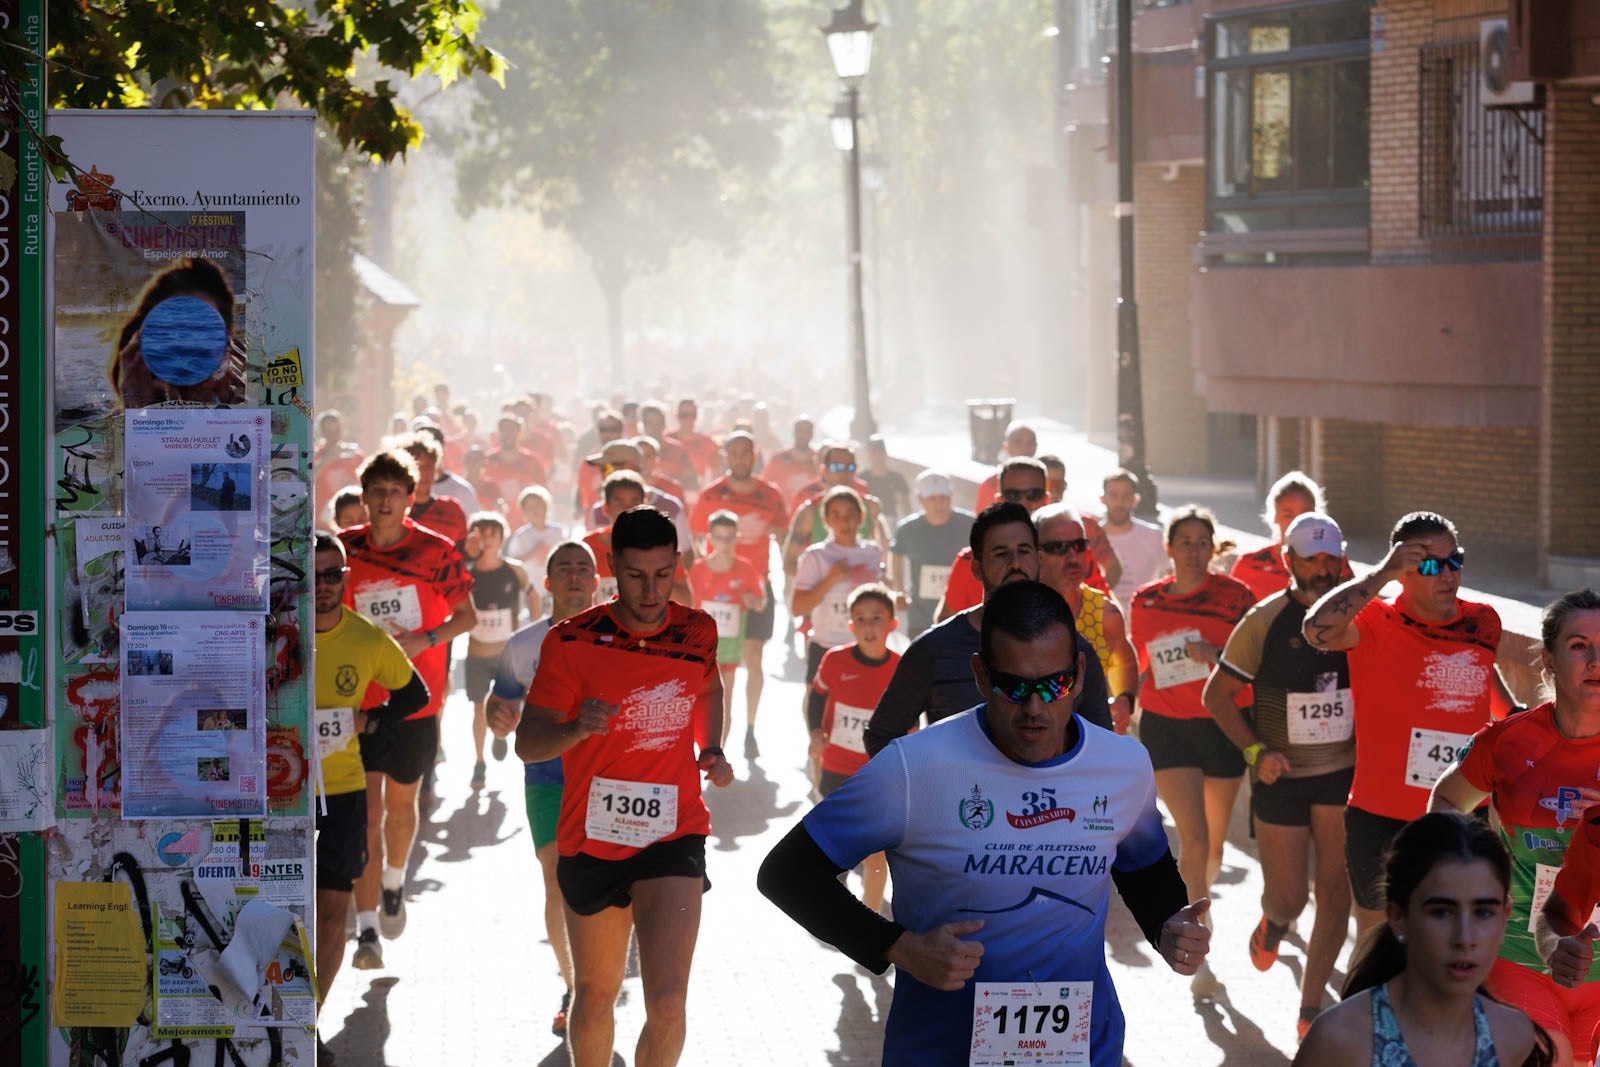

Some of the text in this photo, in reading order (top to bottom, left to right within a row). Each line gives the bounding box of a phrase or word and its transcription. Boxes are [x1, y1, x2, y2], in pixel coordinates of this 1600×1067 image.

[25, 78, 38, 98] la
[25, 109, 38, 130] de
[25, 142, 38, 203] Fuente
[133, 190, 300, 210] Excmo. Ayuntamiento
[199, 215, 234, 226] FESTIVAL
[25, 214, 38, 256] Ruta
[144, 249, 229, 260] Espejos de Amor
[282, 366, 298, 375] NO
[370, 600, 401, 616] 659
[1425, 665, 1486, 681] carrera
[625, 700, 692, 719] carrera
[1298, 701, 1344, 720] 1295
[602, 794, 661, 818] 1308
[1022, 787, 1057, 817] 35
[614, 818, 650, 828] ALEJANDRO
[1013, 808, 1070, 826] ANIVERSARIO
[226, 845, 237, 853] de
[984, 843, 1096, 852] CLUB DE ATLETISMO
[198, 866, 236, 878] OFERTA
[963, 854, 1107, 876] MARACENA
[67, 902, 105, 911] Learning
[993, 1005, 1070, 1034] 1179
[158, 1028, 221, 1037] Mejoramos
